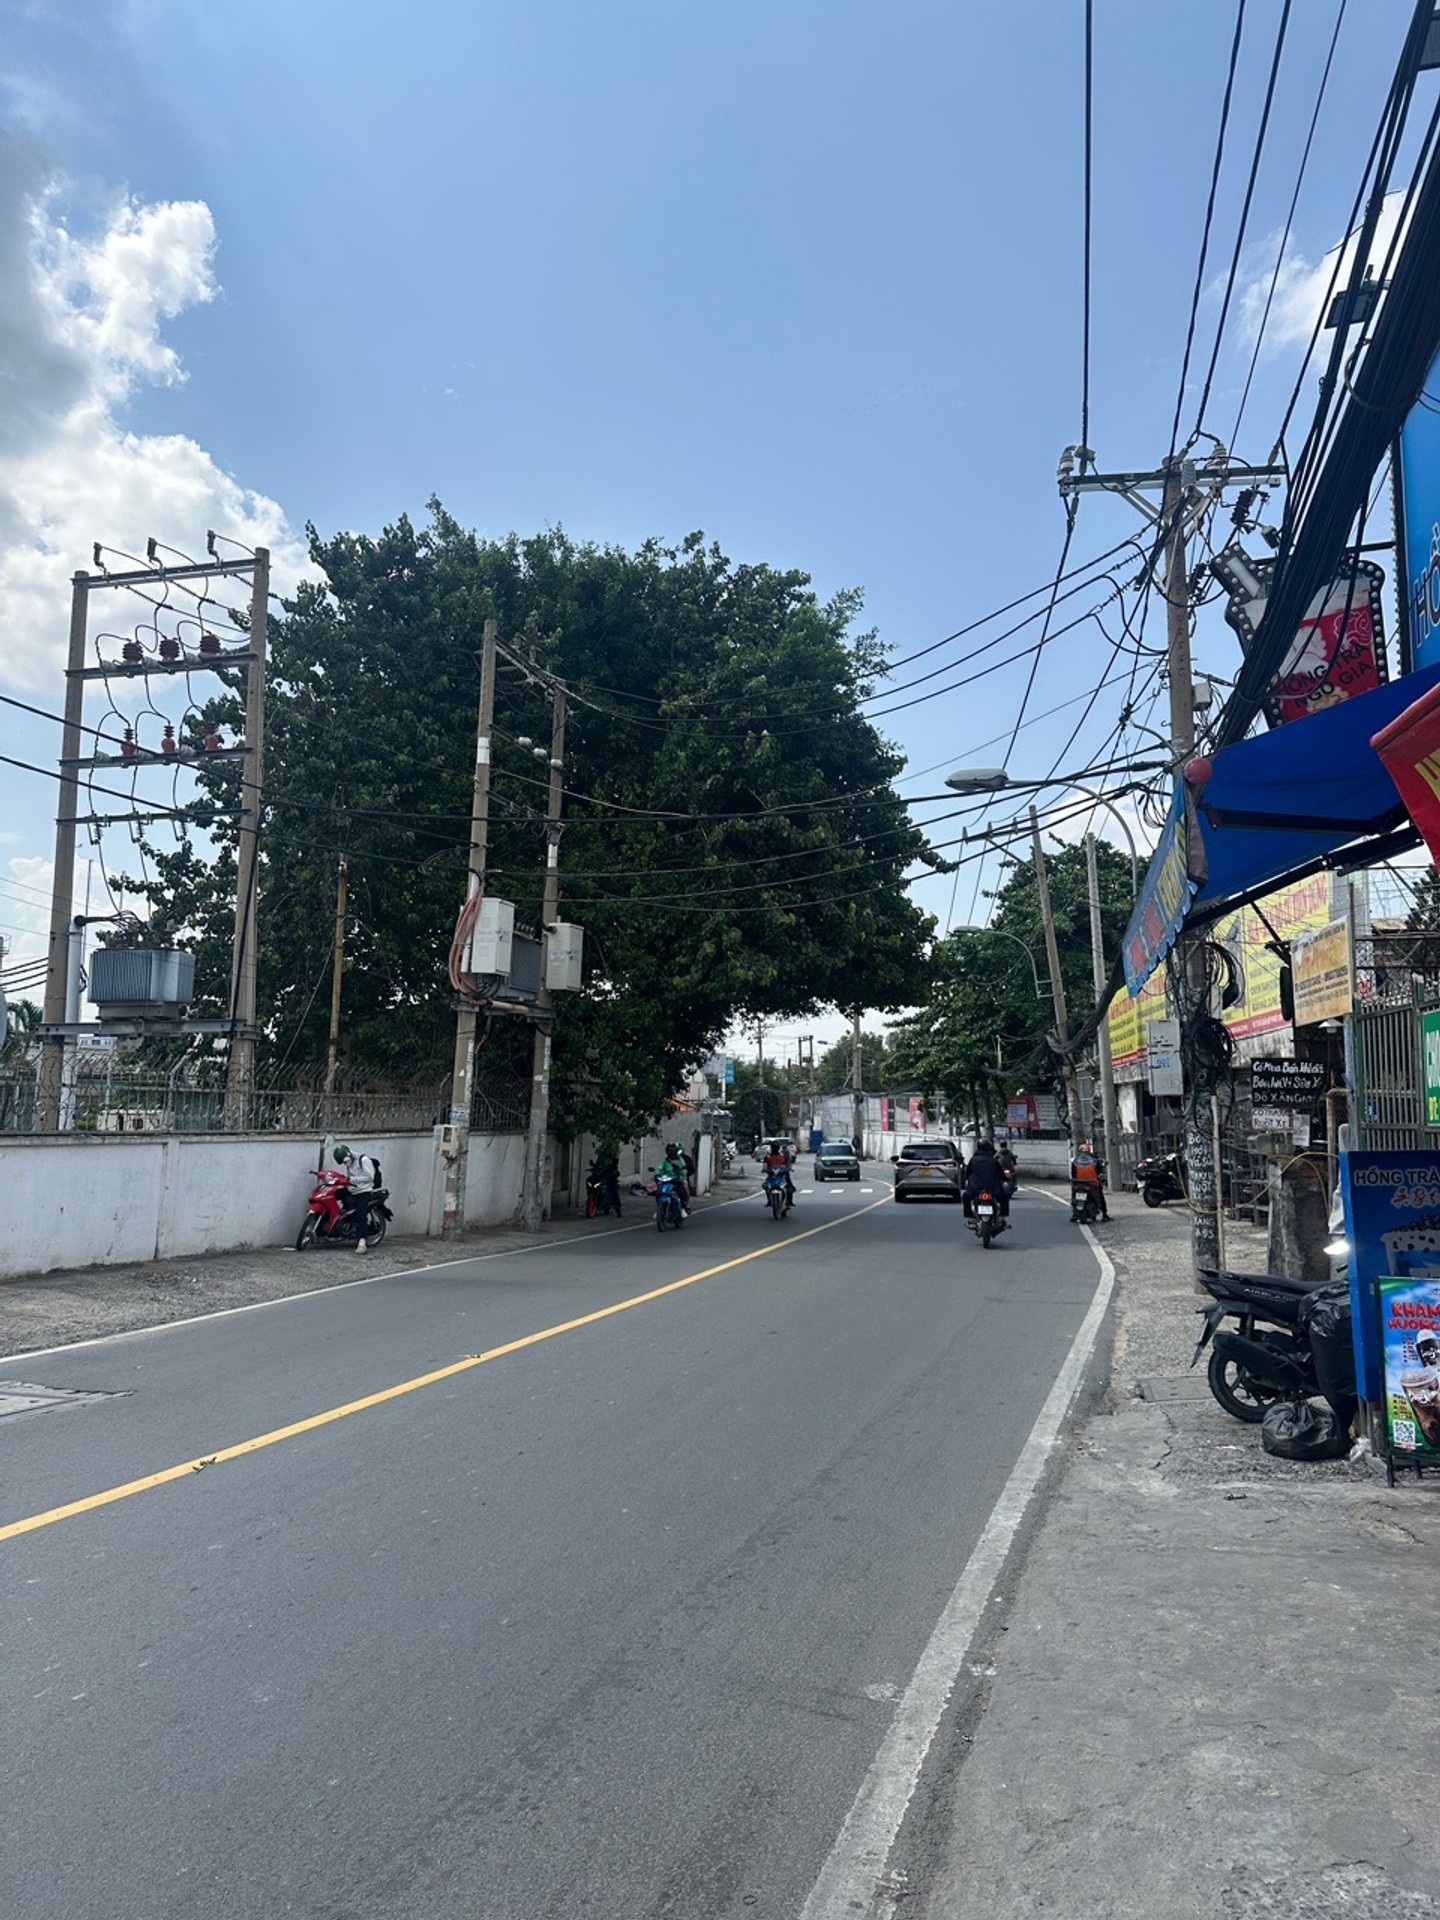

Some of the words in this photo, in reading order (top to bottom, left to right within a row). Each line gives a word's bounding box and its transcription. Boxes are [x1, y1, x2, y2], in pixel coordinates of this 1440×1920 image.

[1338, 662, 1373, 685] GIA
[1354, 1166, 1405, 1186] HỒNG
[1405, 1166, 1440, 1186] TRÀ
[1194, 1228, 1216, 1239] A95
